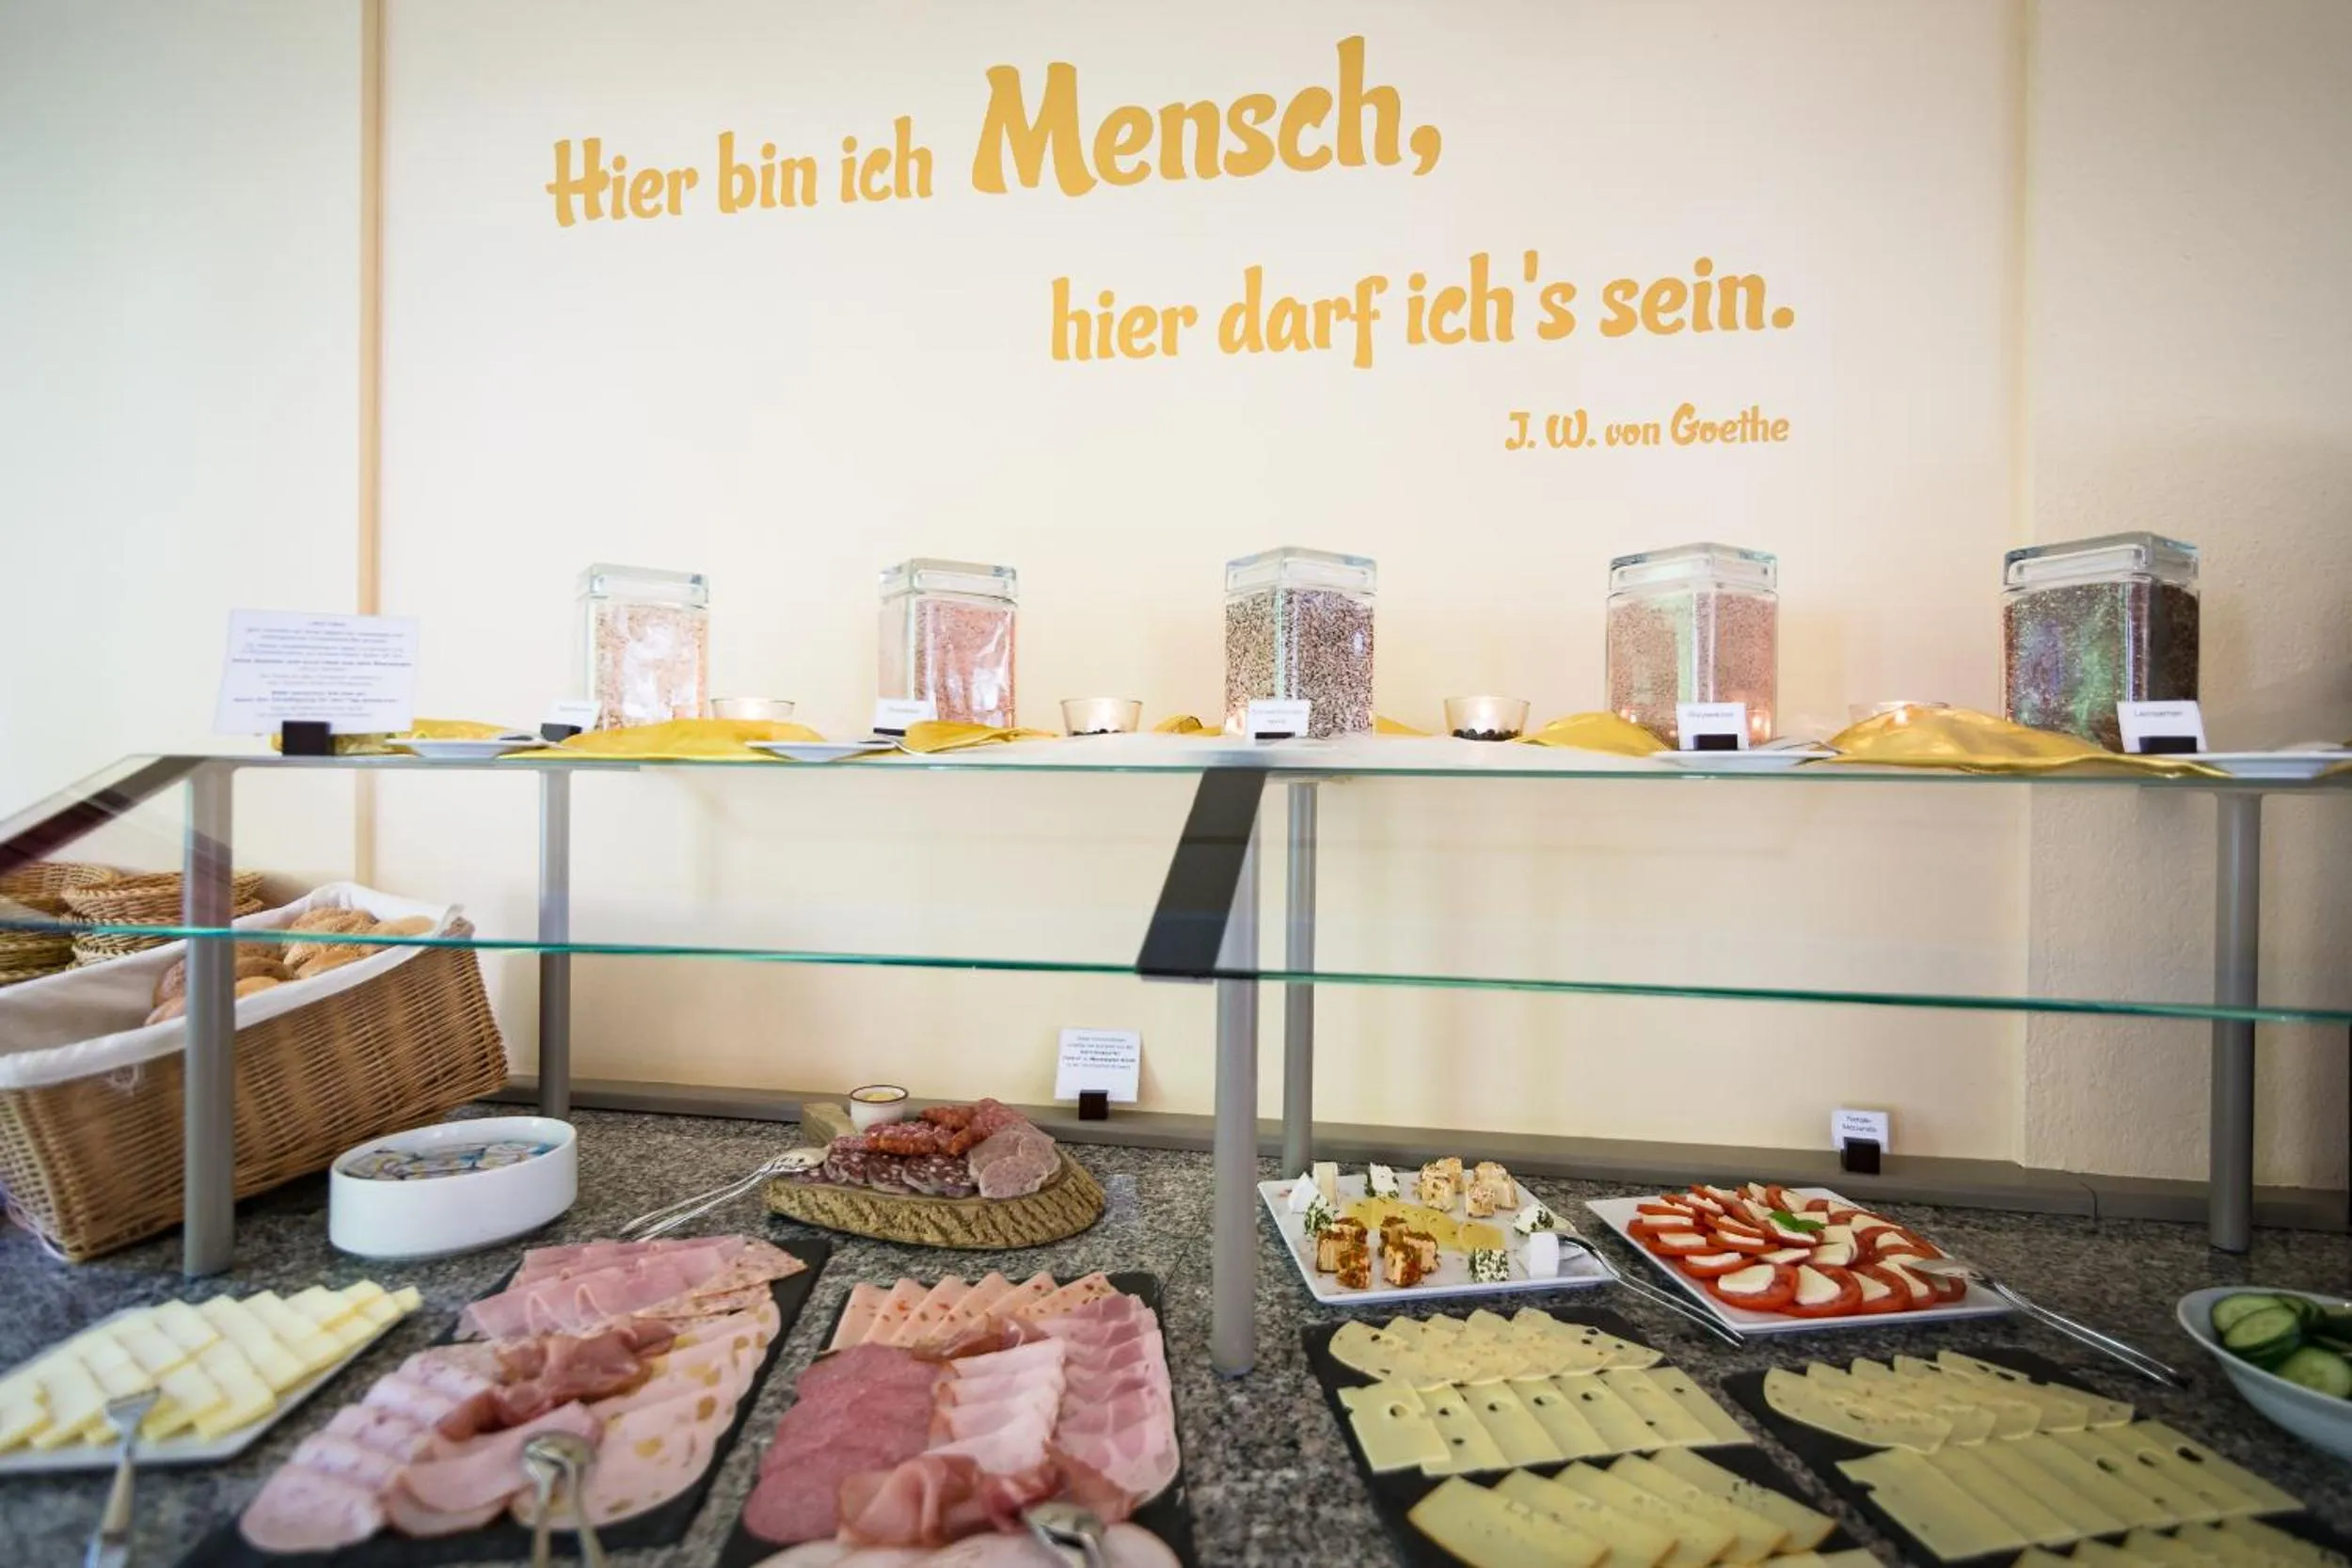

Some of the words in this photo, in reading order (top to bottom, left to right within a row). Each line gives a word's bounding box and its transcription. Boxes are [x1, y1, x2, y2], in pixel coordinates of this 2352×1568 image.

[546, 137, 698, 227] Hier
[718, 131, 818, 214] bin
[840, 115, 933, 203] ich
[971, 35, 1442, 197] Mensch,
[1051, 277, 1198, 361] hier
[1218, 265, 1389, 370] darf
[1406, 250, 1577, 345] ich's
[1598, 257, 1794, 338] sein.
[1504, 411, 1536, 451] J.
[1546, 408, 1597, 449] W.
[1605, 421, 1661, 447] von
[1670, 402, 1790, 446] Goethe
